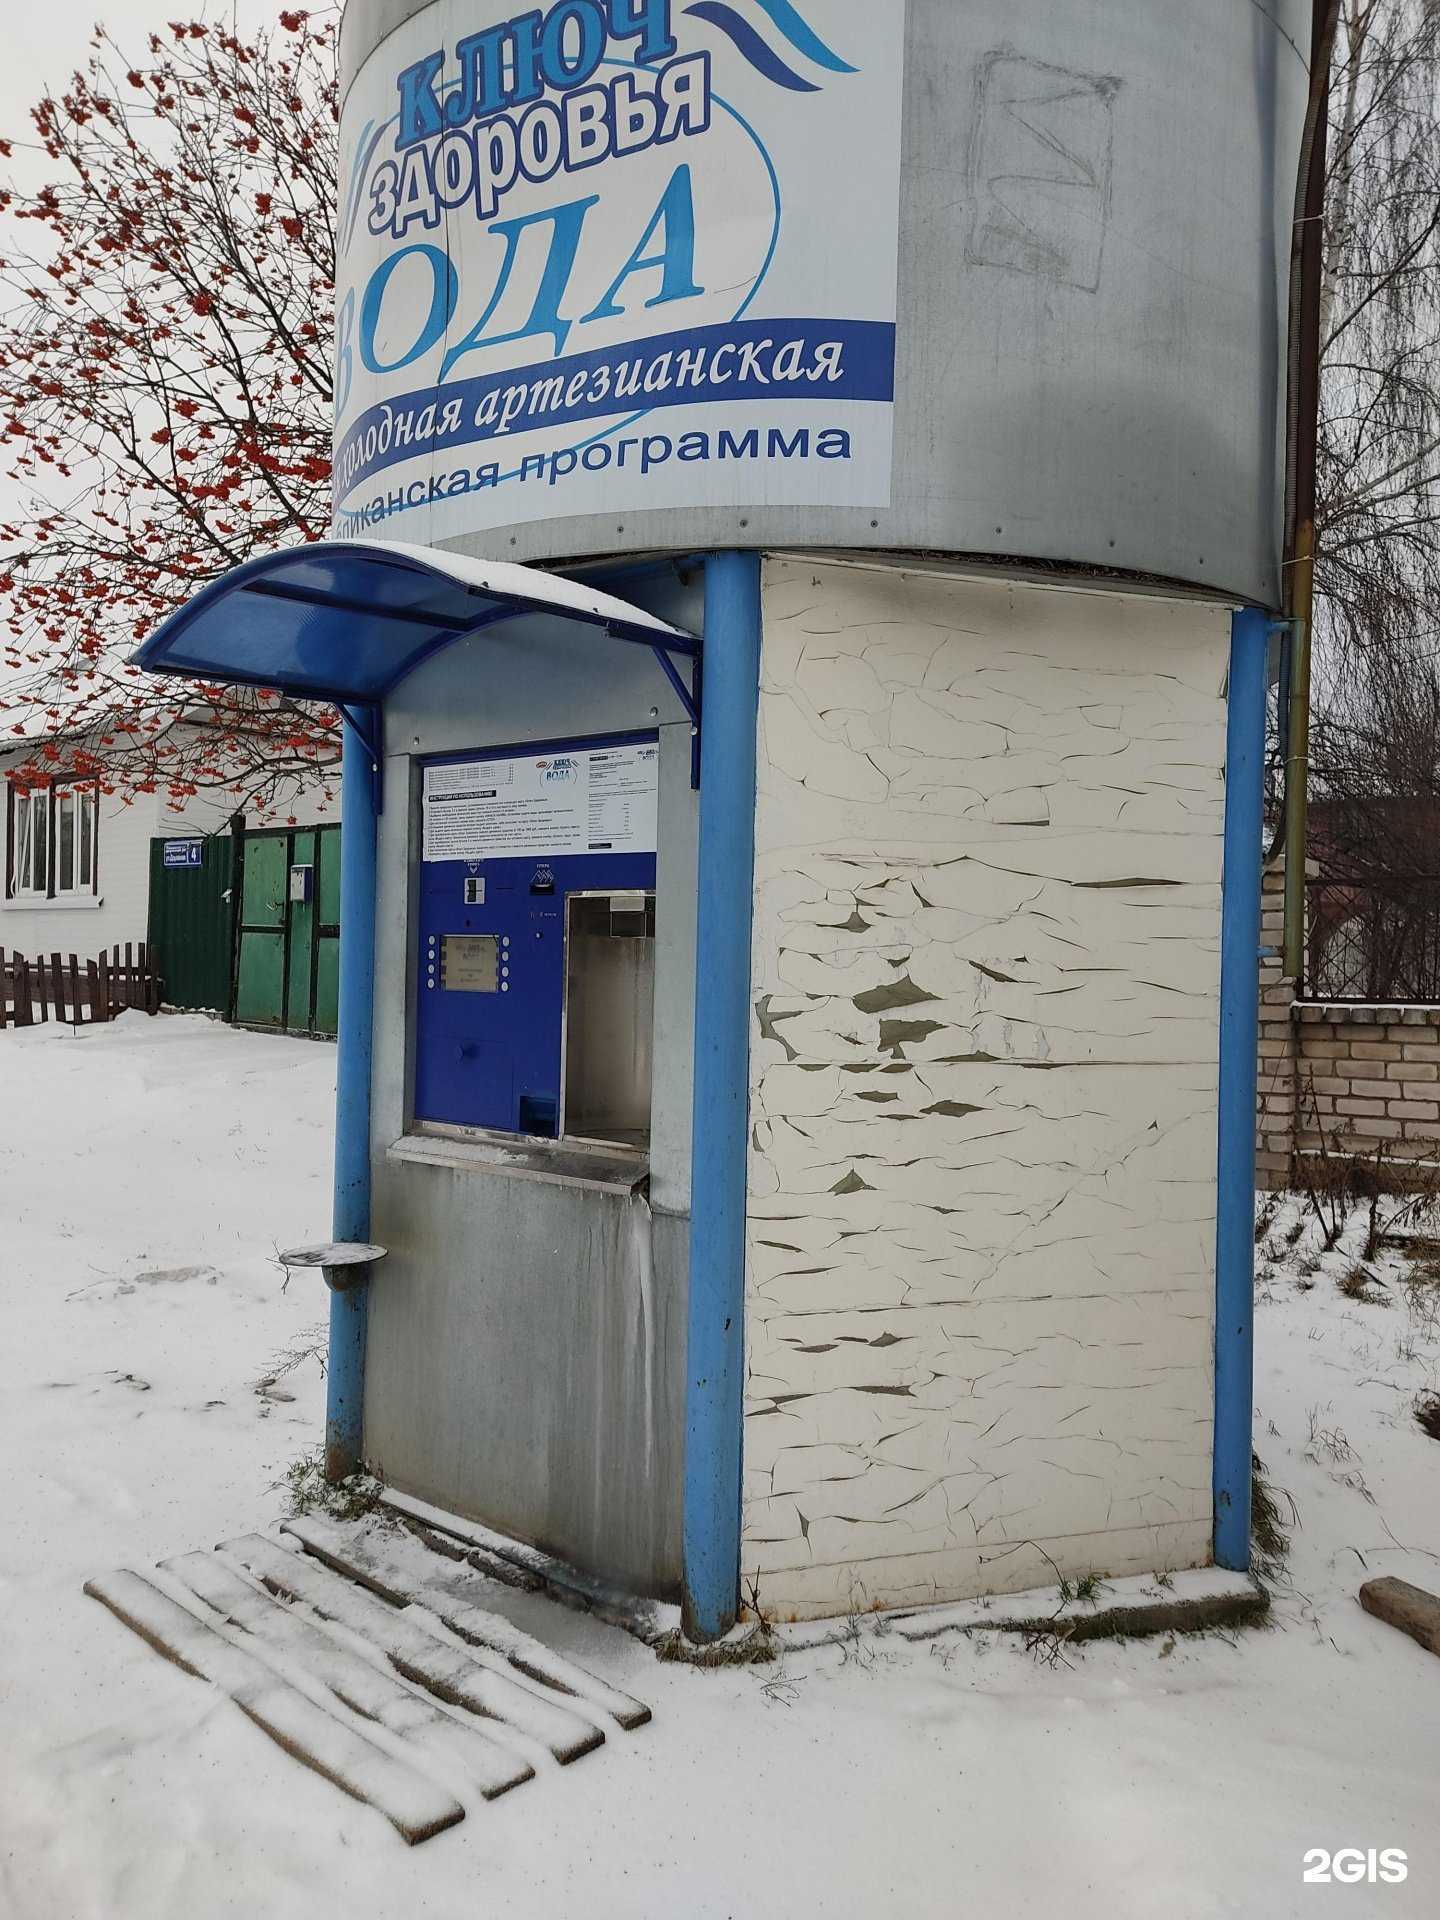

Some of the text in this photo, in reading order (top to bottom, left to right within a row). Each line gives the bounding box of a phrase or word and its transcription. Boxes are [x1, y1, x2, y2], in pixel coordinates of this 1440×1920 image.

[395, 0, 677, 152] КЛЮЧ
[475, 338, 845, 433] артезианская
[520, 427, 852, 485] программа
[191, 847, 197, 862] 4
